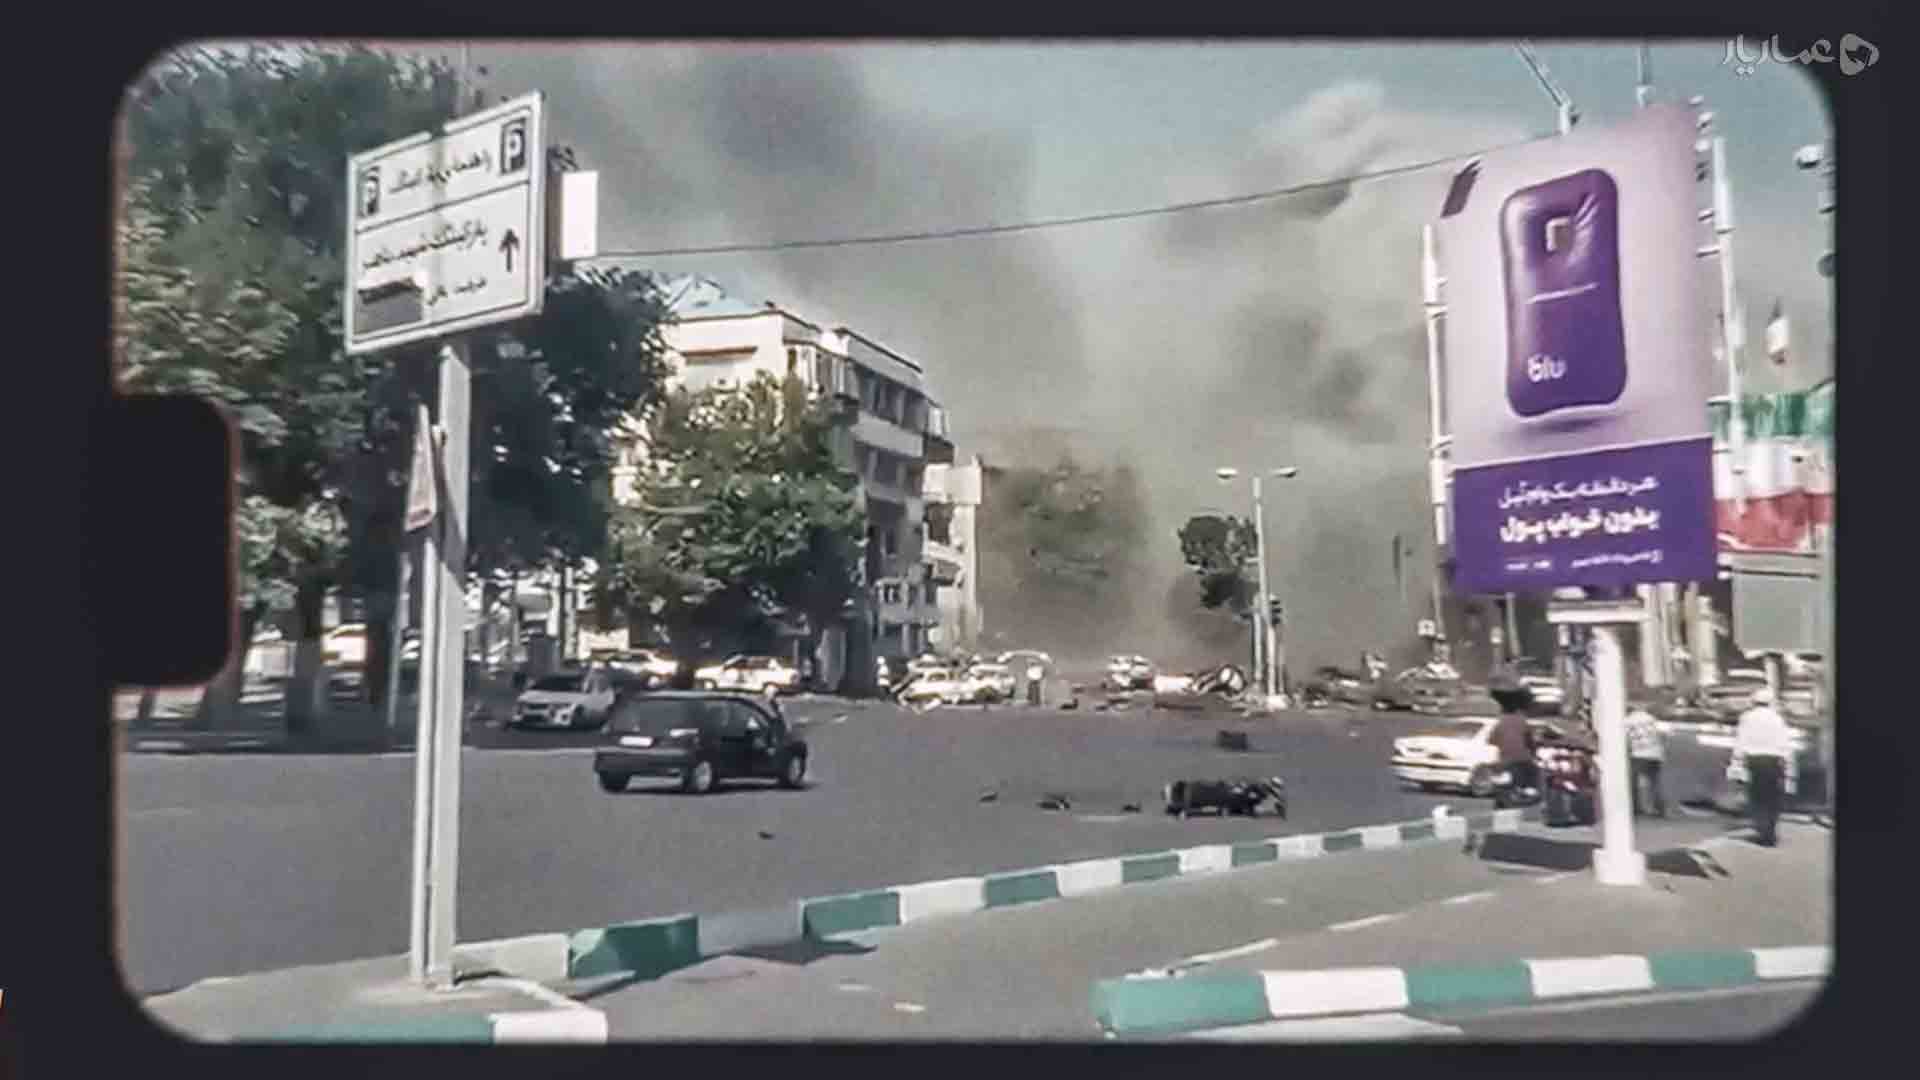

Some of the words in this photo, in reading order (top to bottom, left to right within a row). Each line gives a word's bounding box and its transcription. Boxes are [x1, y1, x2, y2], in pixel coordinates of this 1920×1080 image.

[1499, 515, 1546, 544] پول
[1546, 507, 1601, 539] خواب
[1603, 506, 1661, 535] بدون
